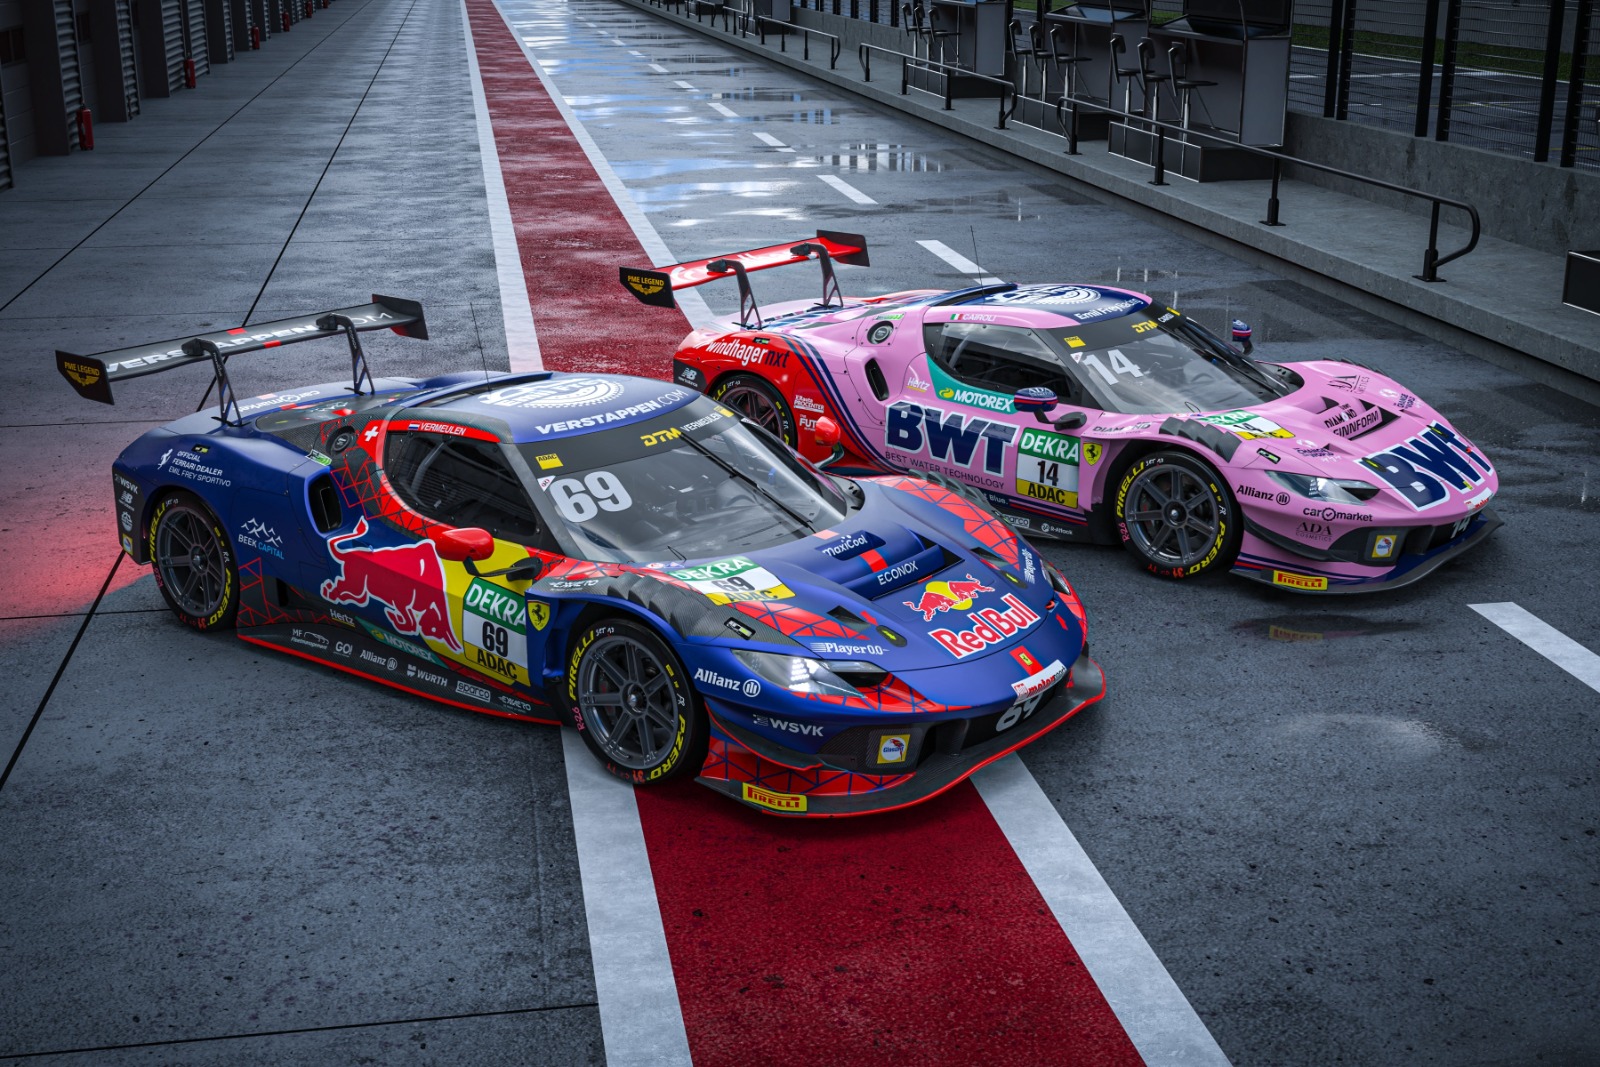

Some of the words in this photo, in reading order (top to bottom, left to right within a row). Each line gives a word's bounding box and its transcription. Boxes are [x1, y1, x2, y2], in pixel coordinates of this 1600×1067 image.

[627, 274, 641, 283] PME
[641, 276, 664, 287] LEGEND
[1131, 320, 1158, 333] DTM
[64, 362, 77, 373] PME
[77, 363, 100, 376] LEGEND
[1080, 349, 1143, 386] 14
[907, 377, 930, 391] Hertz
[535, 388, 689, 435] VERSTAPPEN.COM
[954, 389, 1014, 413] MOTOREX
[421, 422, 467, 435] VERMEULEN
[680, 412, 722, 432] VERMEULEN
[800, 418, 817, 429] FUT
[640, 427, 681, 446] DTM
[886, 399, 1020, 478] BWT
[177, 450, 200, 462] OFFICIAL
[1021, 433, 1079, 463] DEKRA
[168, 466, 182, 476] EMIL
[181, 469, 199, 480] FREY
[197, 474, 231, 487] SPORTIVO
[172, 457, 196, 470] FERRARI
[196, 464, 223, 476] DEALER
[885, 451, 908, 464] BEST
[910, 457, 941, 473] WATER
[943, 466, 1005, 490] TECHNOLOGY
[1037, 459, 1059, 487] 14
[1354, 420, 1496, 512] BWT
[551, 471, 632, 522] 69
[1027, 481, 1066, 505] ADAC
[1116, 461, 1145, 518] PIRELLI
[1236, 484, 1274, 502] Allianz
[150, 502, 166, 563] PIRELLI
[1295, 531, 1332, 541] COSMETICS
[1296, 521, 1332, 535] ADA
[238, 534, 257, 548] BEEK
[257, 542, 285, 560] CAPITAL
[670, 558, 754, 580] DEKRA
[877, 560, 918, 586] ECONOX
[711, 576, 756, 592] 69
[1277, 572, 1322, 588] PIRELLI
[466, 582, 527, 628] DEKRA
[330, 608, 355, 626] Hertz
[292, 628, 303, 637] MF
[481, 620, 508, 658] 69
[335, 641, 353, 655] GO!
[359, 649, 387, 666] Allianz
[383, 632, 437, 664] MOTOREX
[825, 643, 867, 655] Player
[477, 648, 518, 680] ADAC
[568, 630, 594, 701] PIRELLI
[694, 667, 740, 691] Allianz
[457, 682, 490, 699] sparco
[769, 717, 825, 737] WSVK
[747, 786, 801, 809] PIRELLI
